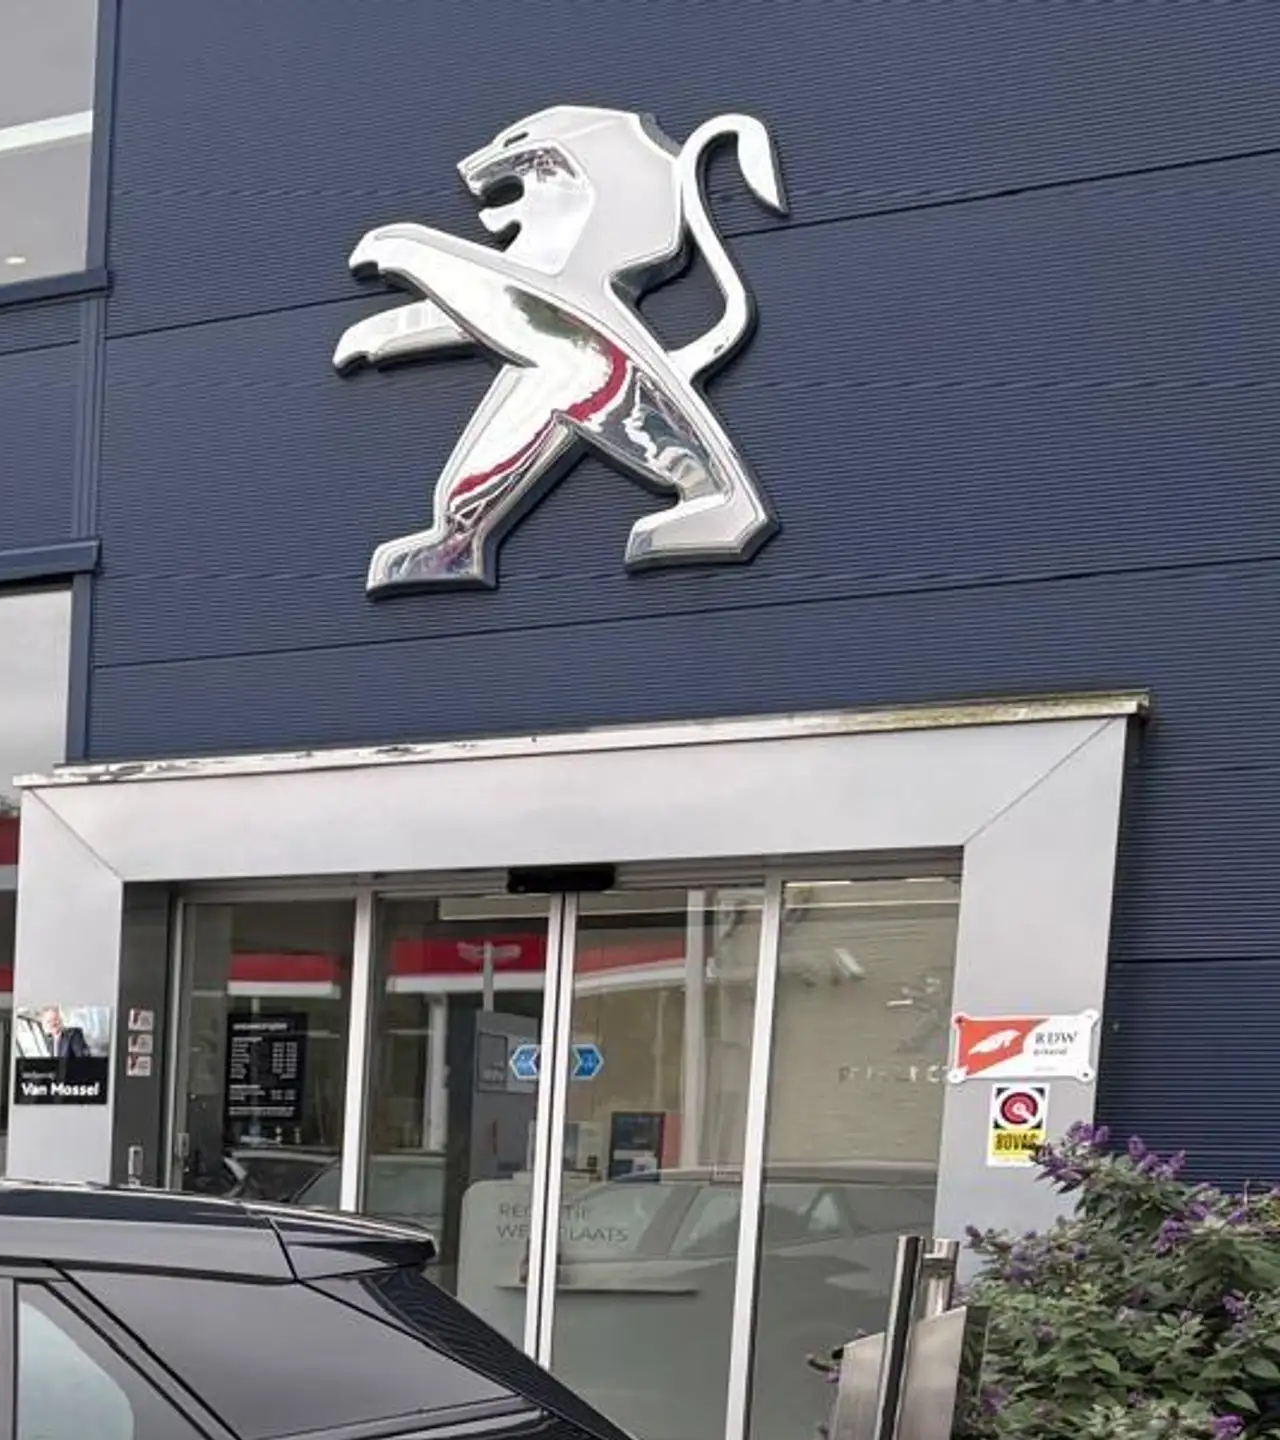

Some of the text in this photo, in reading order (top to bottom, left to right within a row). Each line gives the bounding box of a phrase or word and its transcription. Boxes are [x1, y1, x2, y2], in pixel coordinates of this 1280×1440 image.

[1035, 1030, 1078, 1045] RDW
[21, 1082, 101, 1096] Van Mossel
